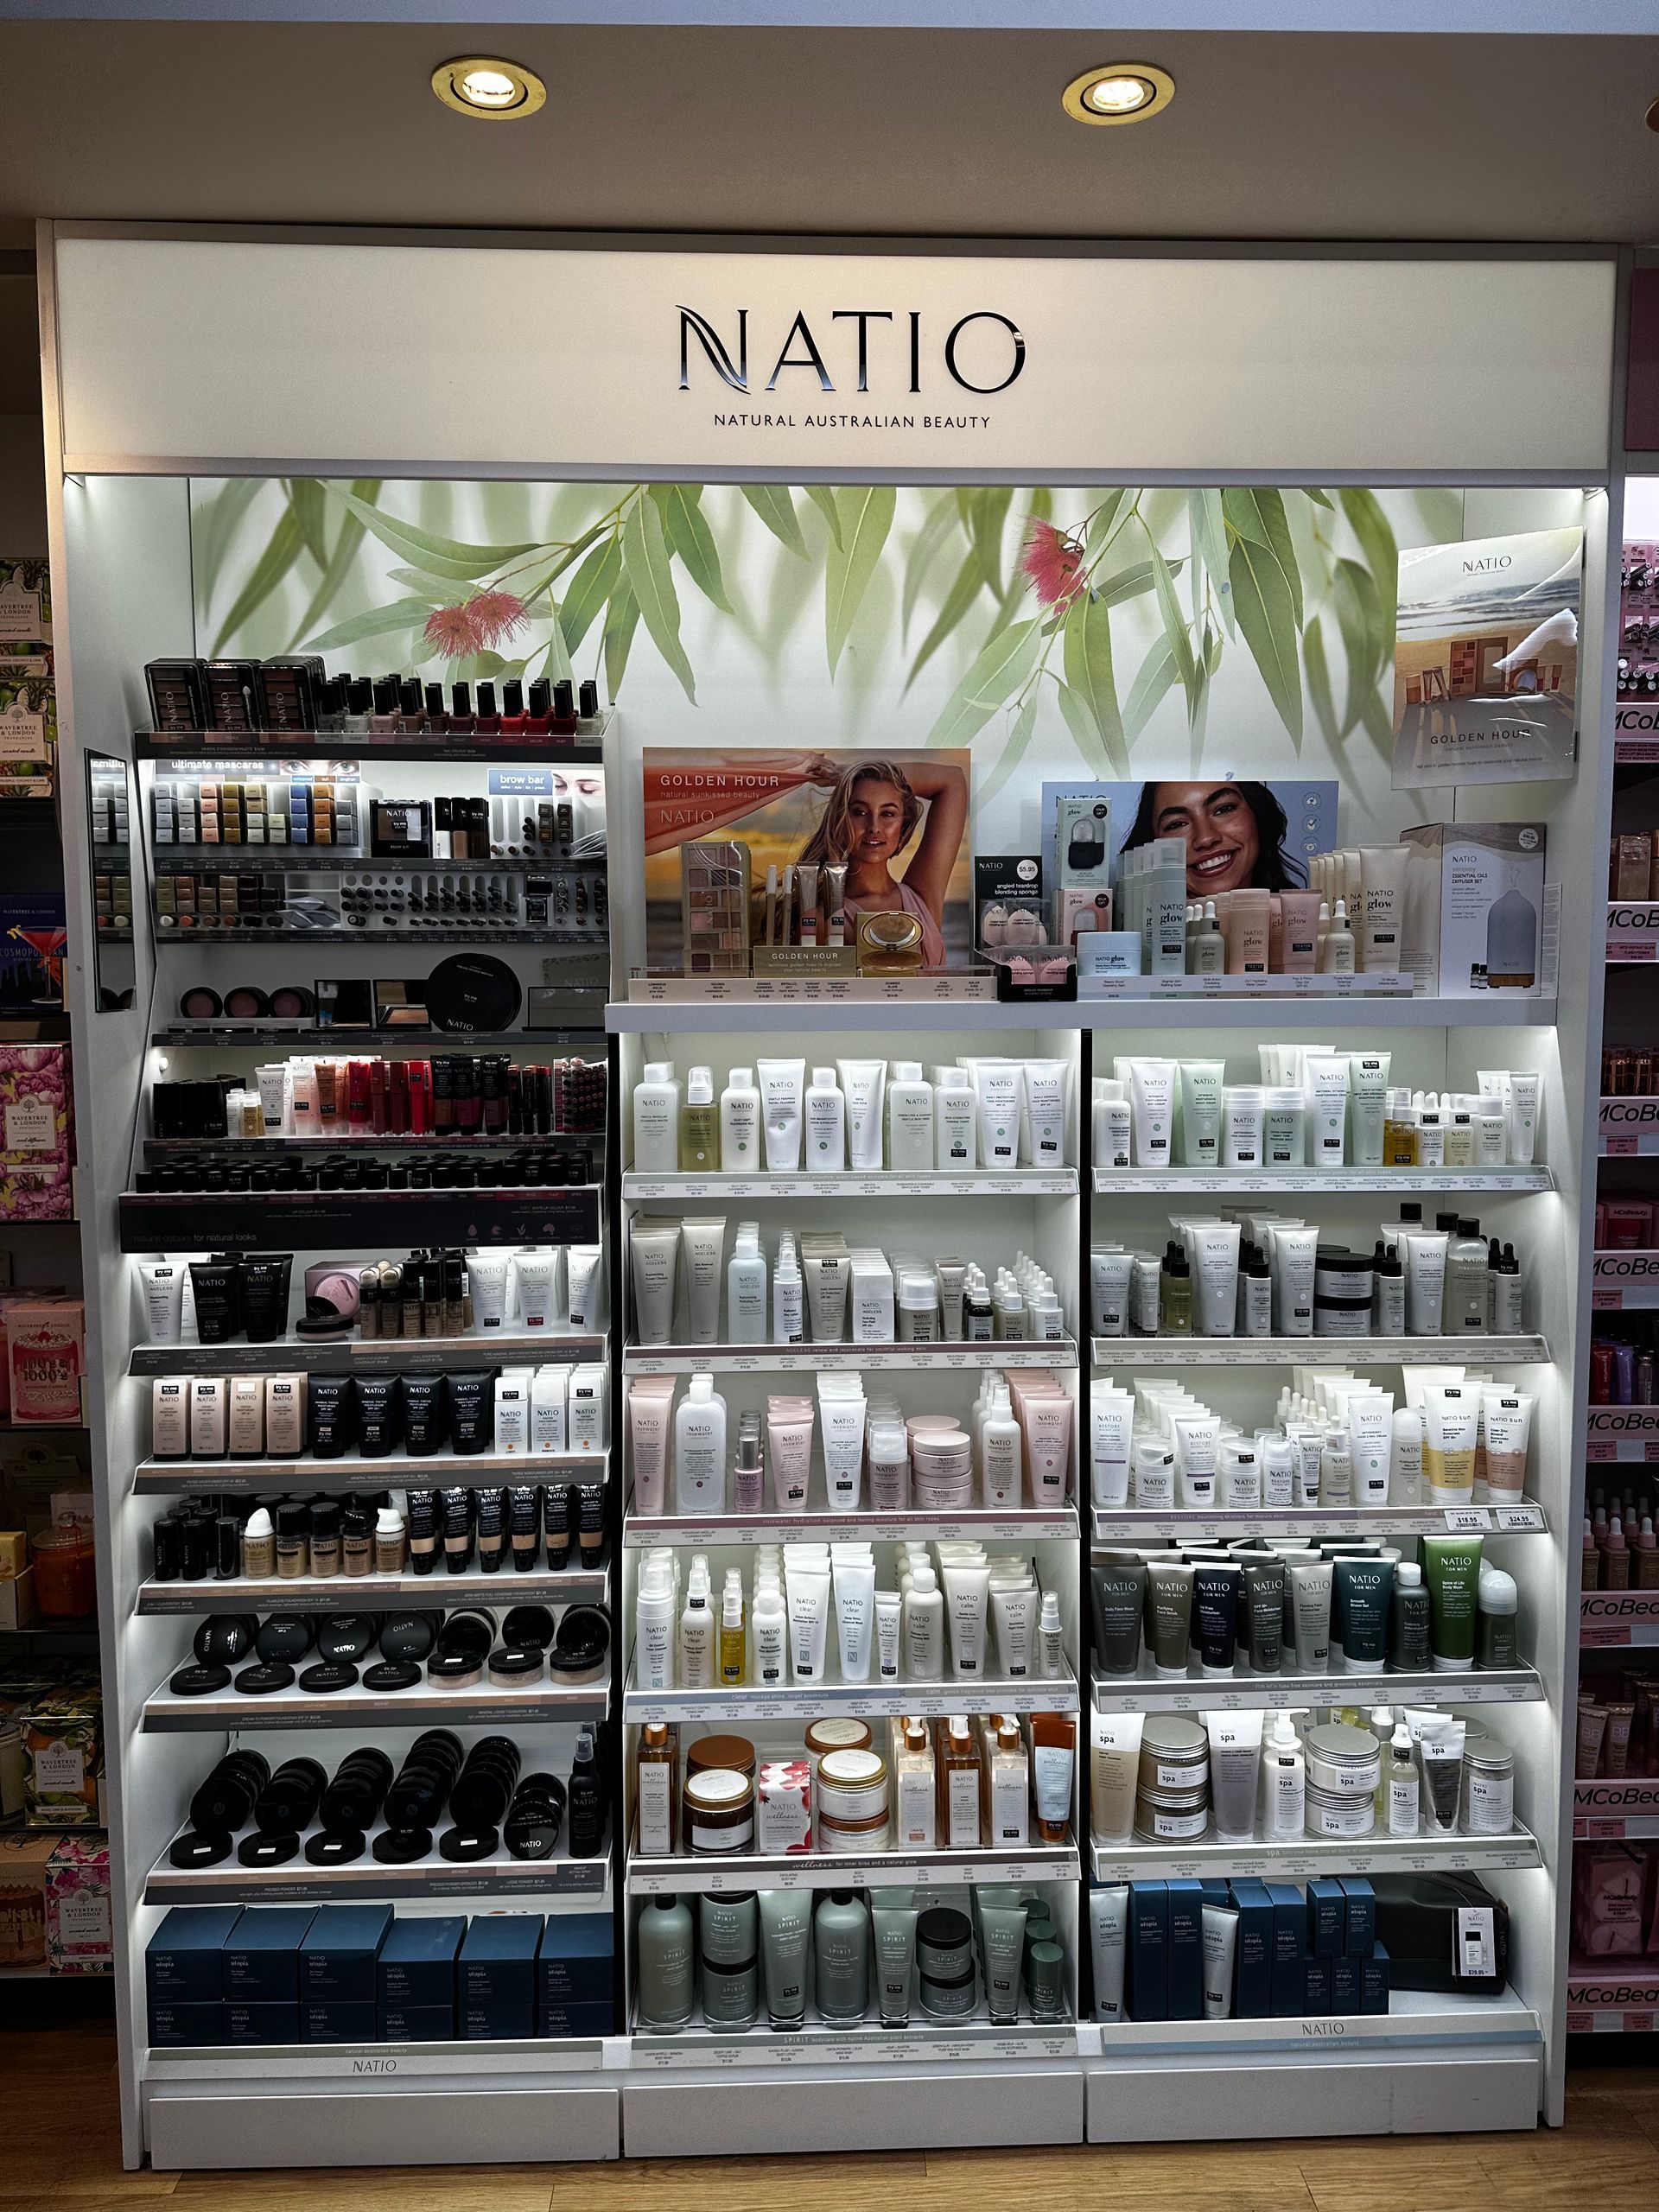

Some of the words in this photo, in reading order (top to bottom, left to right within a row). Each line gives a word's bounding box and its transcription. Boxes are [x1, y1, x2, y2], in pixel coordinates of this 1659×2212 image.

[675, 305, 1026, 395] NATIO
[715, 414, 796, 427] NATURAL
[804, 415, 914, 428] AUSTRALIAN
[924, 416, 990, 429] BEAUTY
[1463, 556, 1512, 573] NATIO
[1431, 734, 1484, 744] GOLDEN
[1492, 729, 1530, 740] HOUR
[171, 760, 212, 769] ultimate
[215, 760, 264, 769] mascaras
[500, 775, 524, 784] brow
[528, 775, 544, 784] bar
[660, 775, 727, 786] GOLDEN
[734, 776, 779, 786] HOUR
[660, 810, 714, 823] NATIO
[1367, 899, 1392, 911] glow
[1160, 912, 1183, 925] glow
[1243, 938, 1262, 947] glow
[448, 1019, 474, 1031] NATIO
[207, 1233, 233, 1242] natural
[1440, 1557, 1471, 1566] NATIO
[1349, 1575, 1381, 1584] NATIO
[1103, 1582, 1138, 1591] NATIO
[1156, 1582, 1188, 1592] NATIO
[1198, 1582, 1230, 1592] NATIO
[1253, 1580, 1283, 1592] NATIO
[779, 1920, 799, 1929] SPIRIT
[1302, 2023, 1344, 2036] NATIO
[353, 2060, 397, 2072] NATIO
